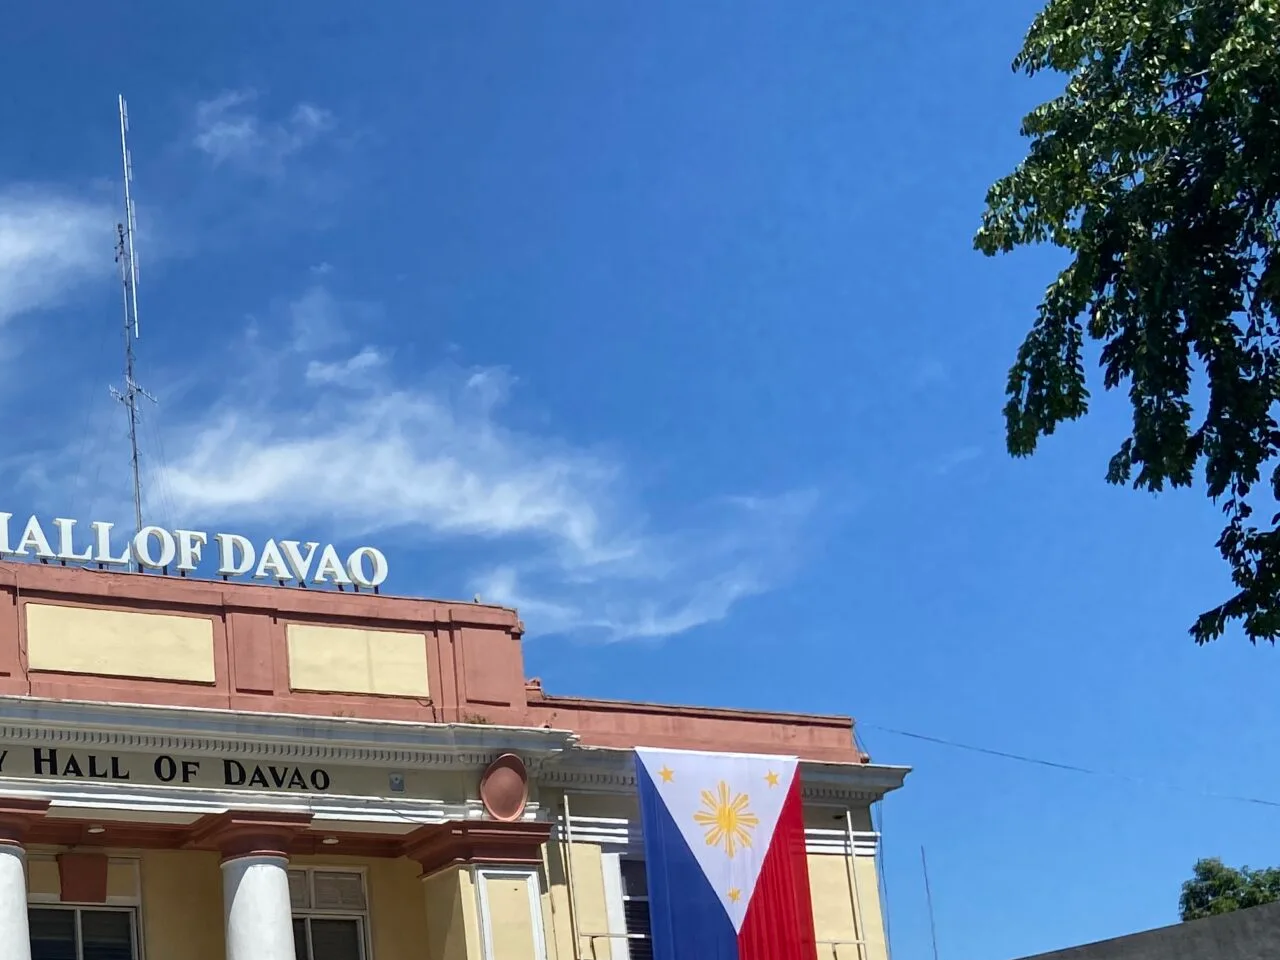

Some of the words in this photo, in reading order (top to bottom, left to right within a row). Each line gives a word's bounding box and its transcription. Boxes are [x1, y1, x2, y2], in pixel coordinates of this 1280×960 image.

[133, 525, 207, 570] OF
[215, 532, 389, 588] DAVAO
[33, 747, 130, 780] HALL
[154, 755, 200, 783] OF
[223, 759, 330, 791] DAVAO
